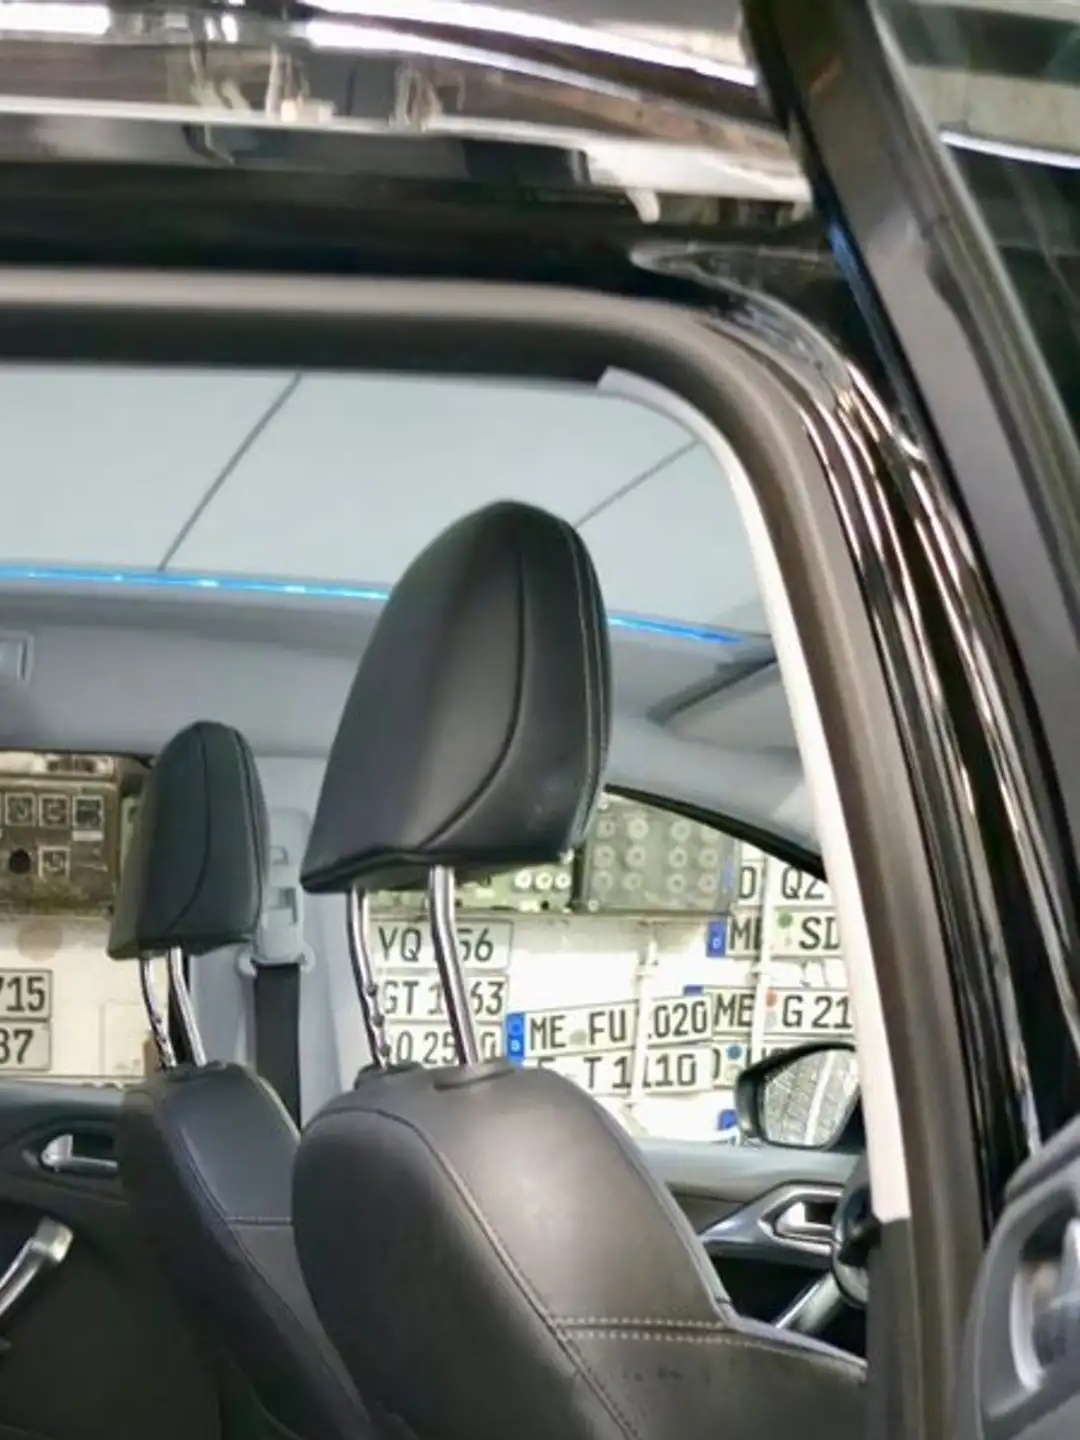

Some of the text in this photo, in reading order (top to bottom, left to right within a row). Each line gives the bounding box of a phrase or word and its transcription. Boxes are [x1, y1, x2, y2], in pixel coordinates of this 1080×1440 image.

[782, 994, 803, 1028] G
[529, 1014, 567, 1052] ME
[589, 1009, 627, 1046] FU
